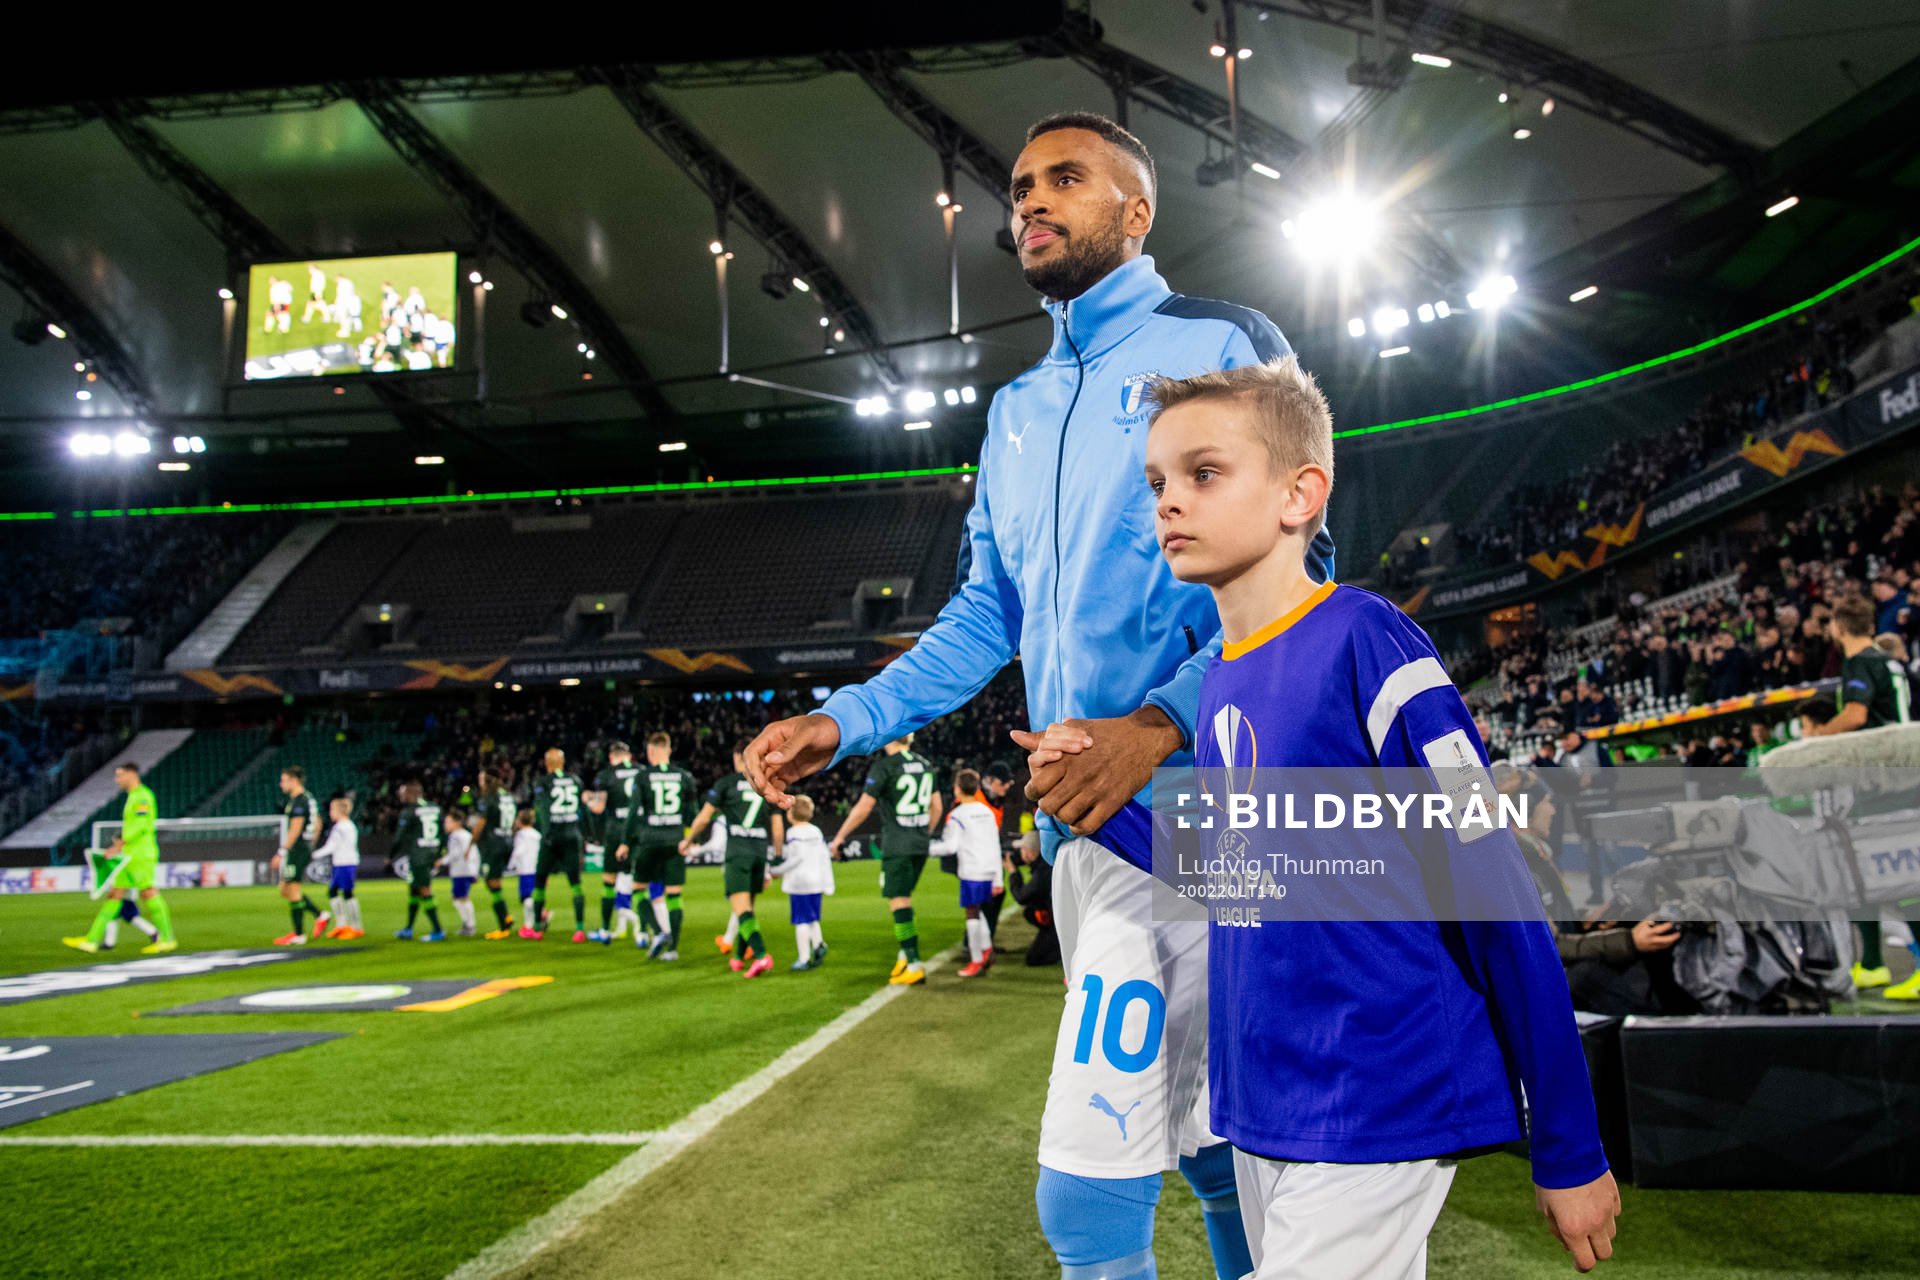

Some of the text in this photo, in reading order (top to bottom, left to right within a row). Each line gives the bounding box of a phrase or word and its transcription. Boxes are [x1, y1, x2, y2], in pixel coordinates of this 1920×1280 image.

[550, 785, 579, 814] 25
[651, 781, 681, 815] 13
[742, 790, 764, 828] 7
[896, 772, 933, 815] 24
[1216, 906, 1262, 928] LEAGUE
[1074, 974, 1167, 1074] 10
